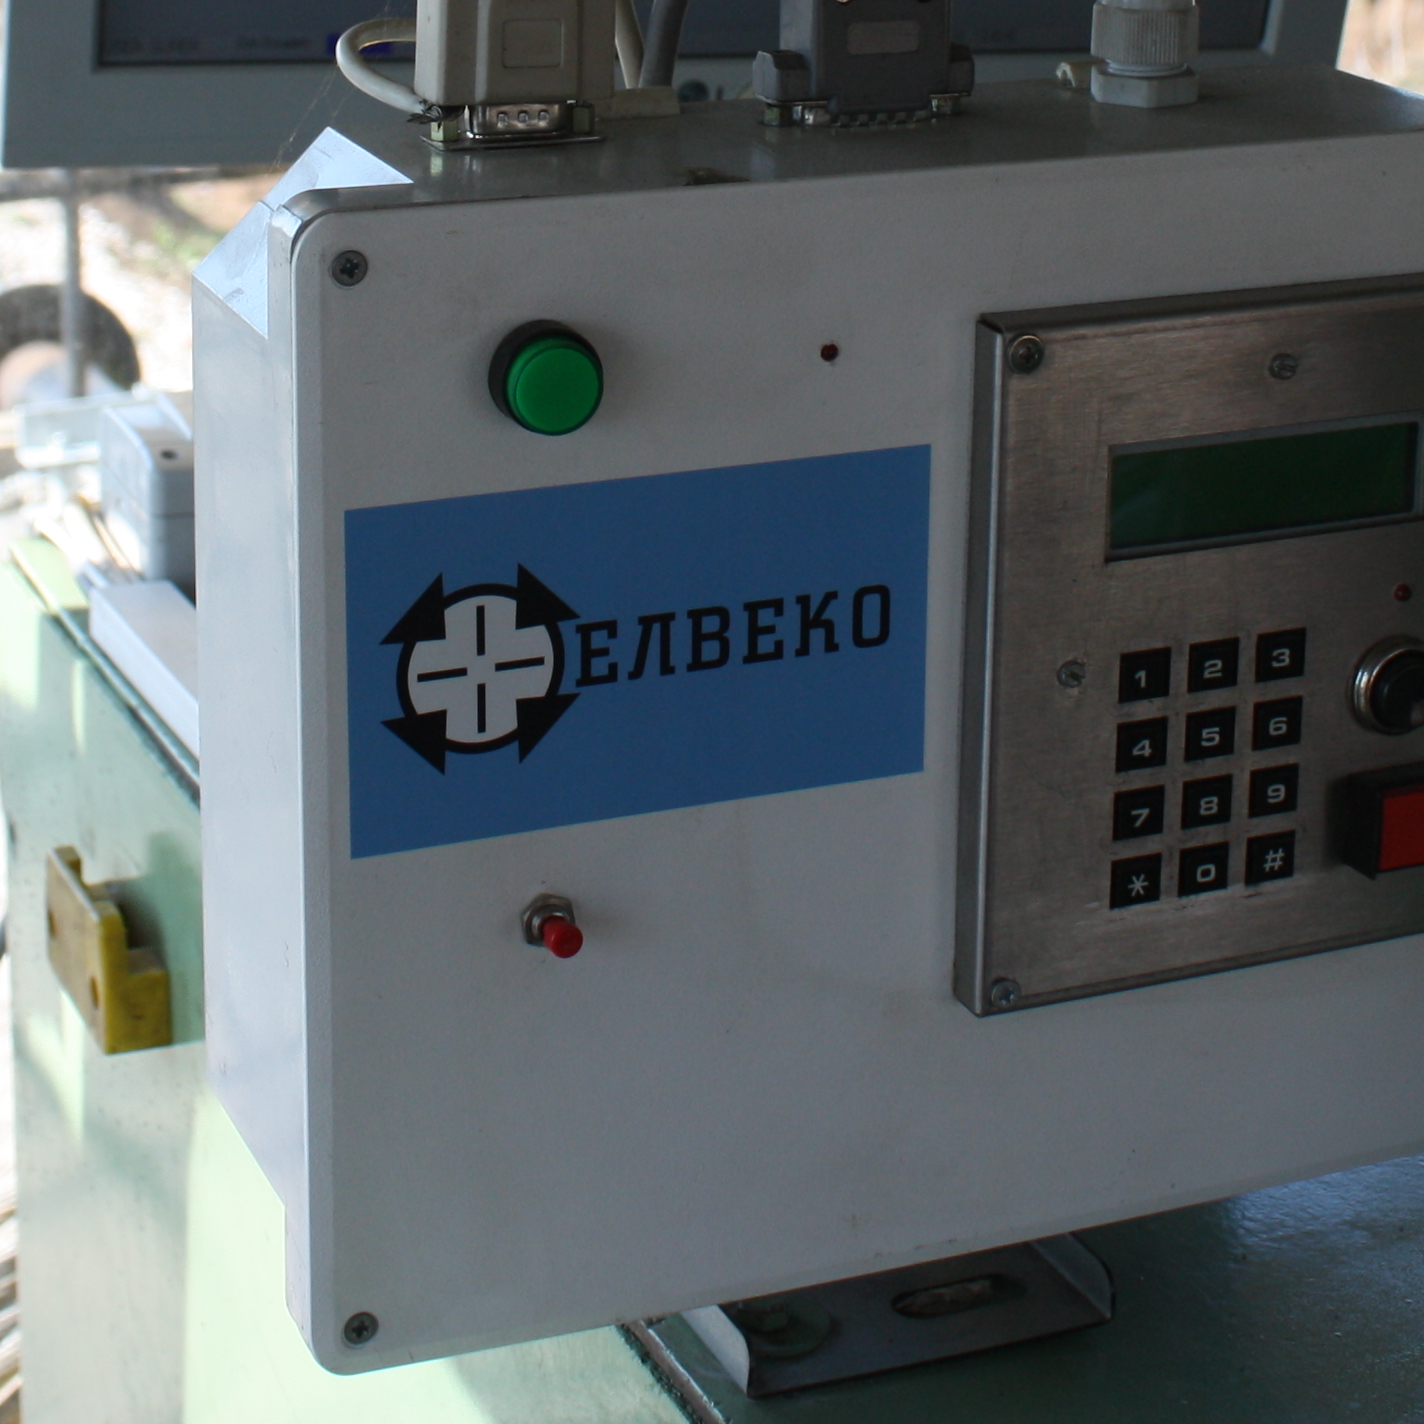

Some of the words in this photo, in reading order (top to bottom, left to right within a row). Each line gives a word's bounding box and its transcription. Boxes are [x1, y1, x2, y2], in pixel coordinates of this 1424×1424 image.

[576, 583, 891, 688] ЕЛВЕКО
[1134, 669, 1147, 688] 1
[1203, 659, 1223, 679] 2
[1271, 648, 1290, 667] 3
[1132, 739, 1152, 757] 4
[1201, 728, 1220, 747] 5
[1269, 717, 1288, 735] 6
[1131, 808, 1150, 827] 7
[1199, 796, 1218, 816] 8
[1267, 784, 1285, 803] 9
[1196, 864, 1216, 883] 0
[1263, 848, 1285, 871] #
